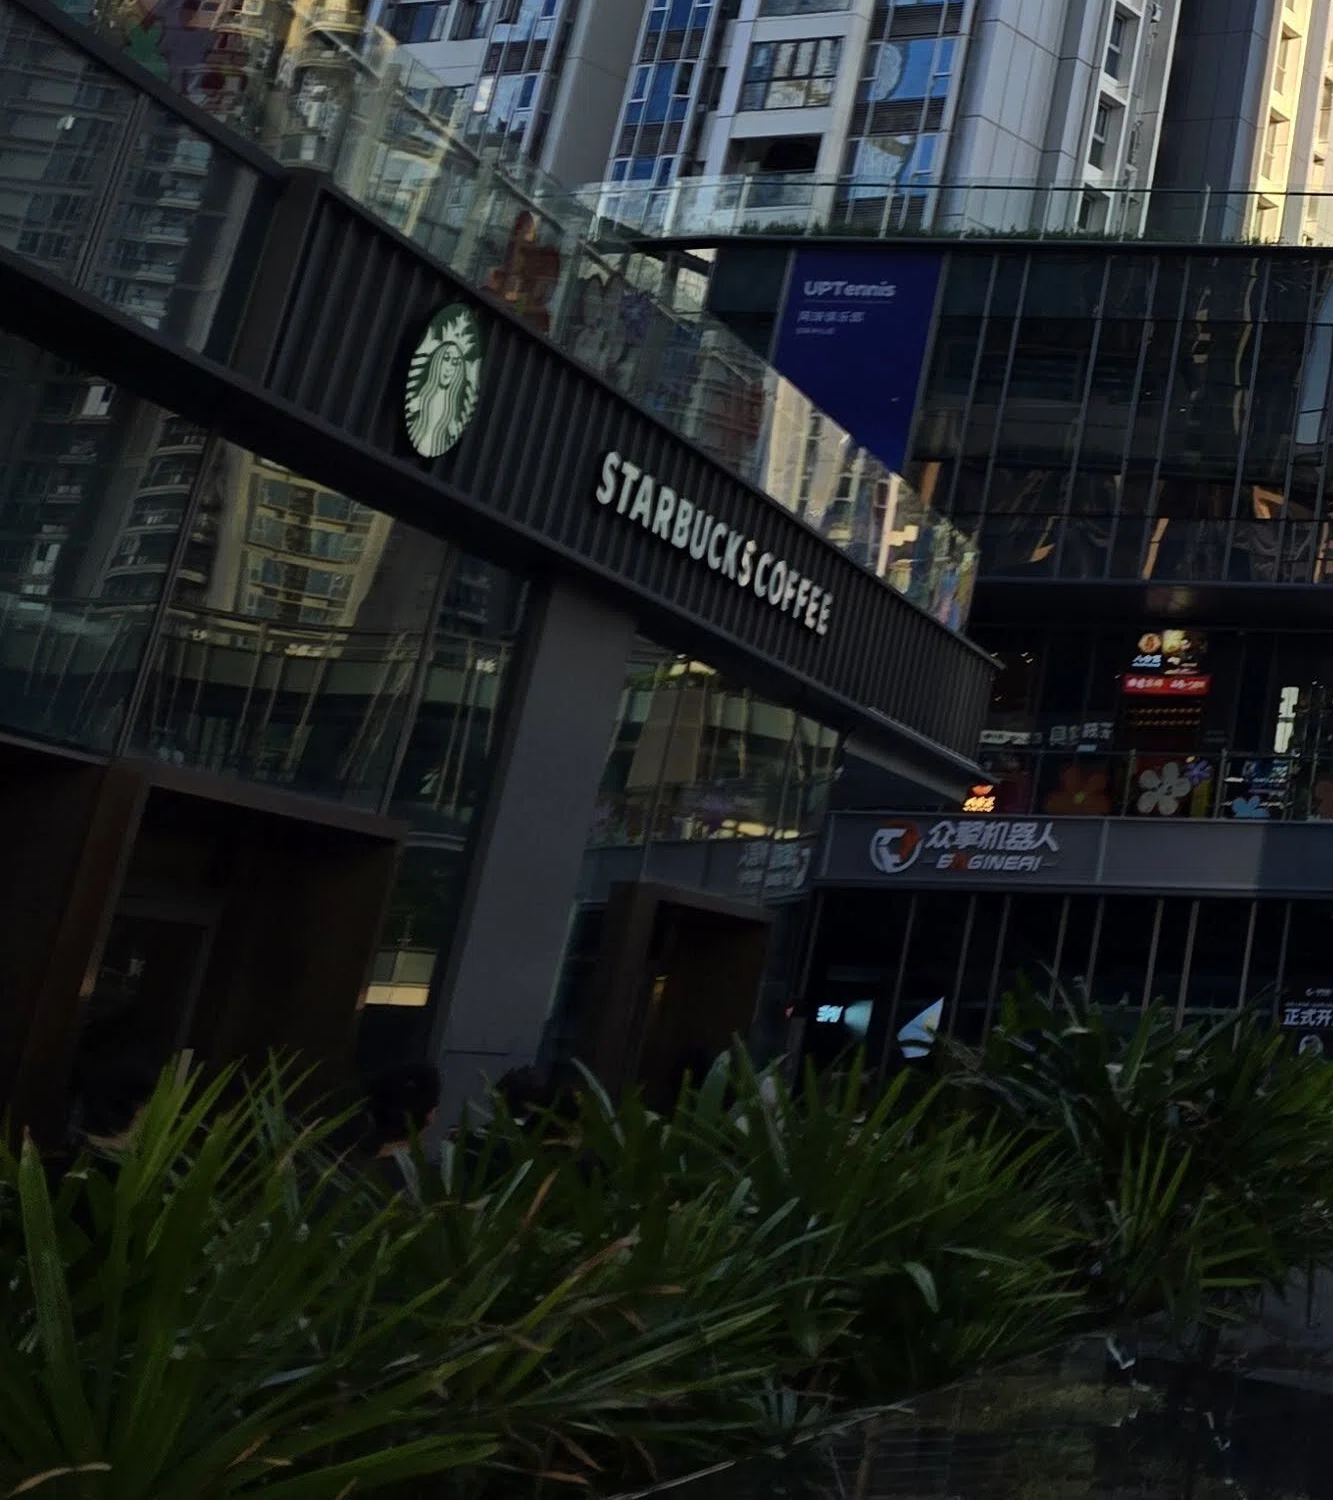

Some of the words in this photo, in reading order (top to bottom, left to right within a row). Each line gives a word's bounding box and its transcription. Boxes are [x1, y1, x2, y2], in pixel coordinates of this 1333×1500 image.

[803, 280, 896, 297] UPTennis
[596, 451, 757, 587] STARBUCKS
[754, 552, 833, 636] COFFEE
[924, 820, 1059, 852] 众擎机器人
